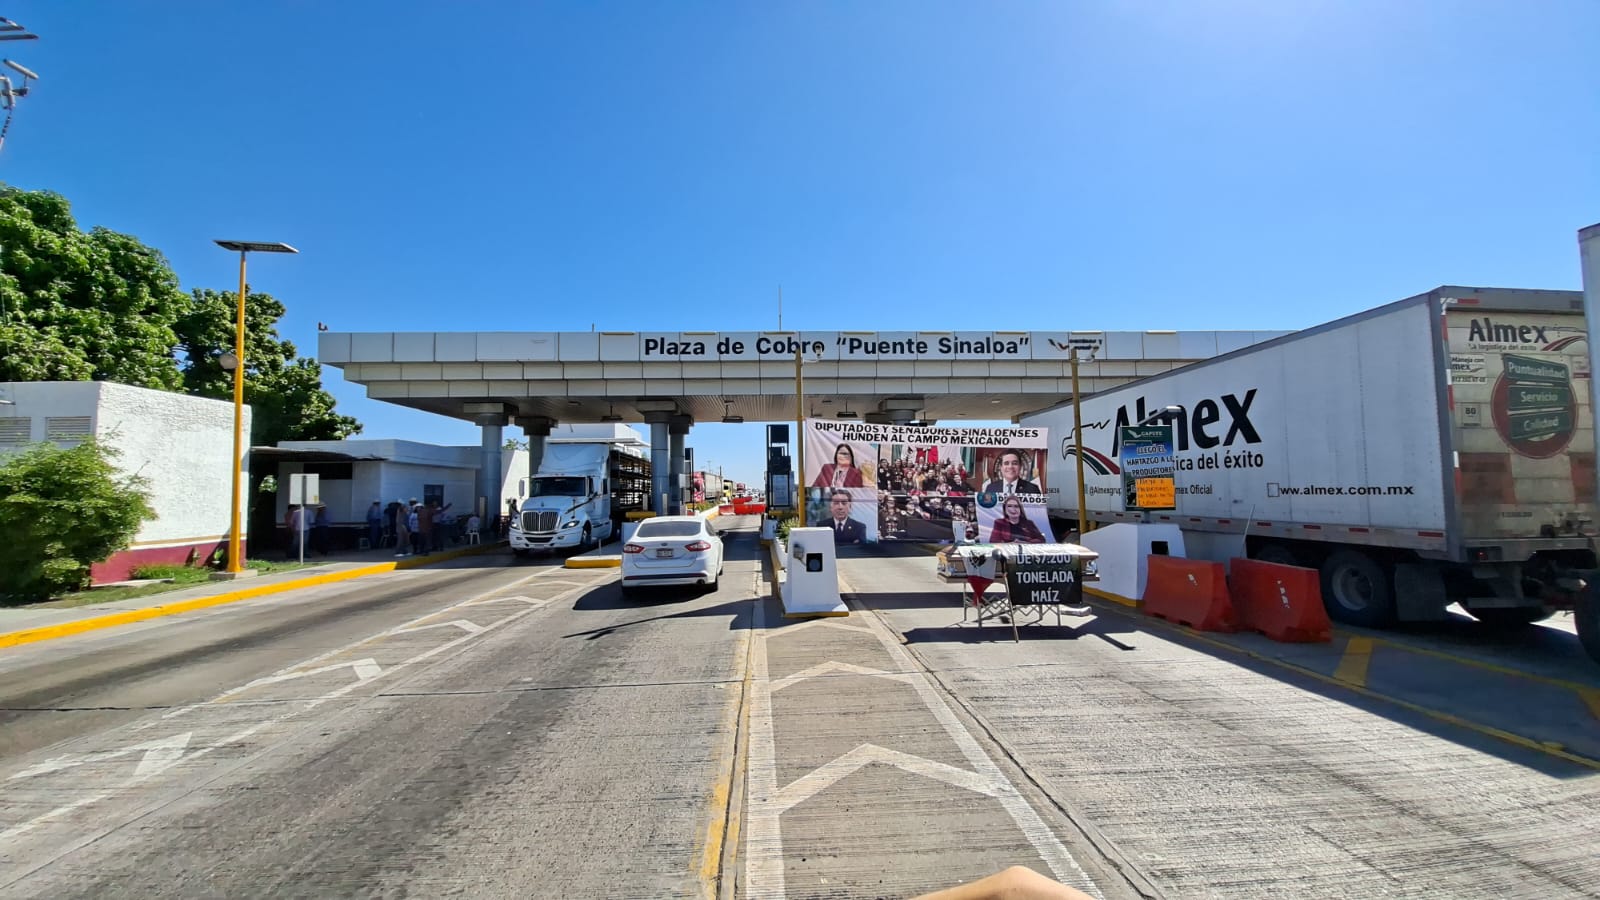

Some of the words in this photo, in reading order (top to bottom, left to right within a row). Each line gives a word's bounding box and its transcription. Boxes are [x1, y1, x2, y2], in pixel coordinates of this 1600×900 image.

[1468, 317, 1549, 344] Almex
[645, 337, 705, 355] Plaza
[716, 337, 744, 355] de
[755, 337, 825, 355] Cobro
[1520, 391, 1559, 402] Servicio
[815, 422, 879, 433] DIPUTADOS
[882, 425, 890, 433] Y
[891, 426, 959, 436] SENADORES
[961, 428, 1039, 438] SINALOENSES
[842, 432, 888, 442] HUNDEN
[890, 434, 904, 443] AL
[907, 435, 948, 444] CAMPO
[950, 436, 1010, 446] MEXICANO
[1197, 453, 1219, 470] del
[1224, 450, 1264, 469] éxito
[1089, 486, 1122, 497] @Almexgrup
[1190, 484, 1213, 495] Oficial
[1017, 553, 1032, 564] DE
[1016, 570, 1074, 584] TONELADA
[1031, 586, 1060, 603] MAÍZ
